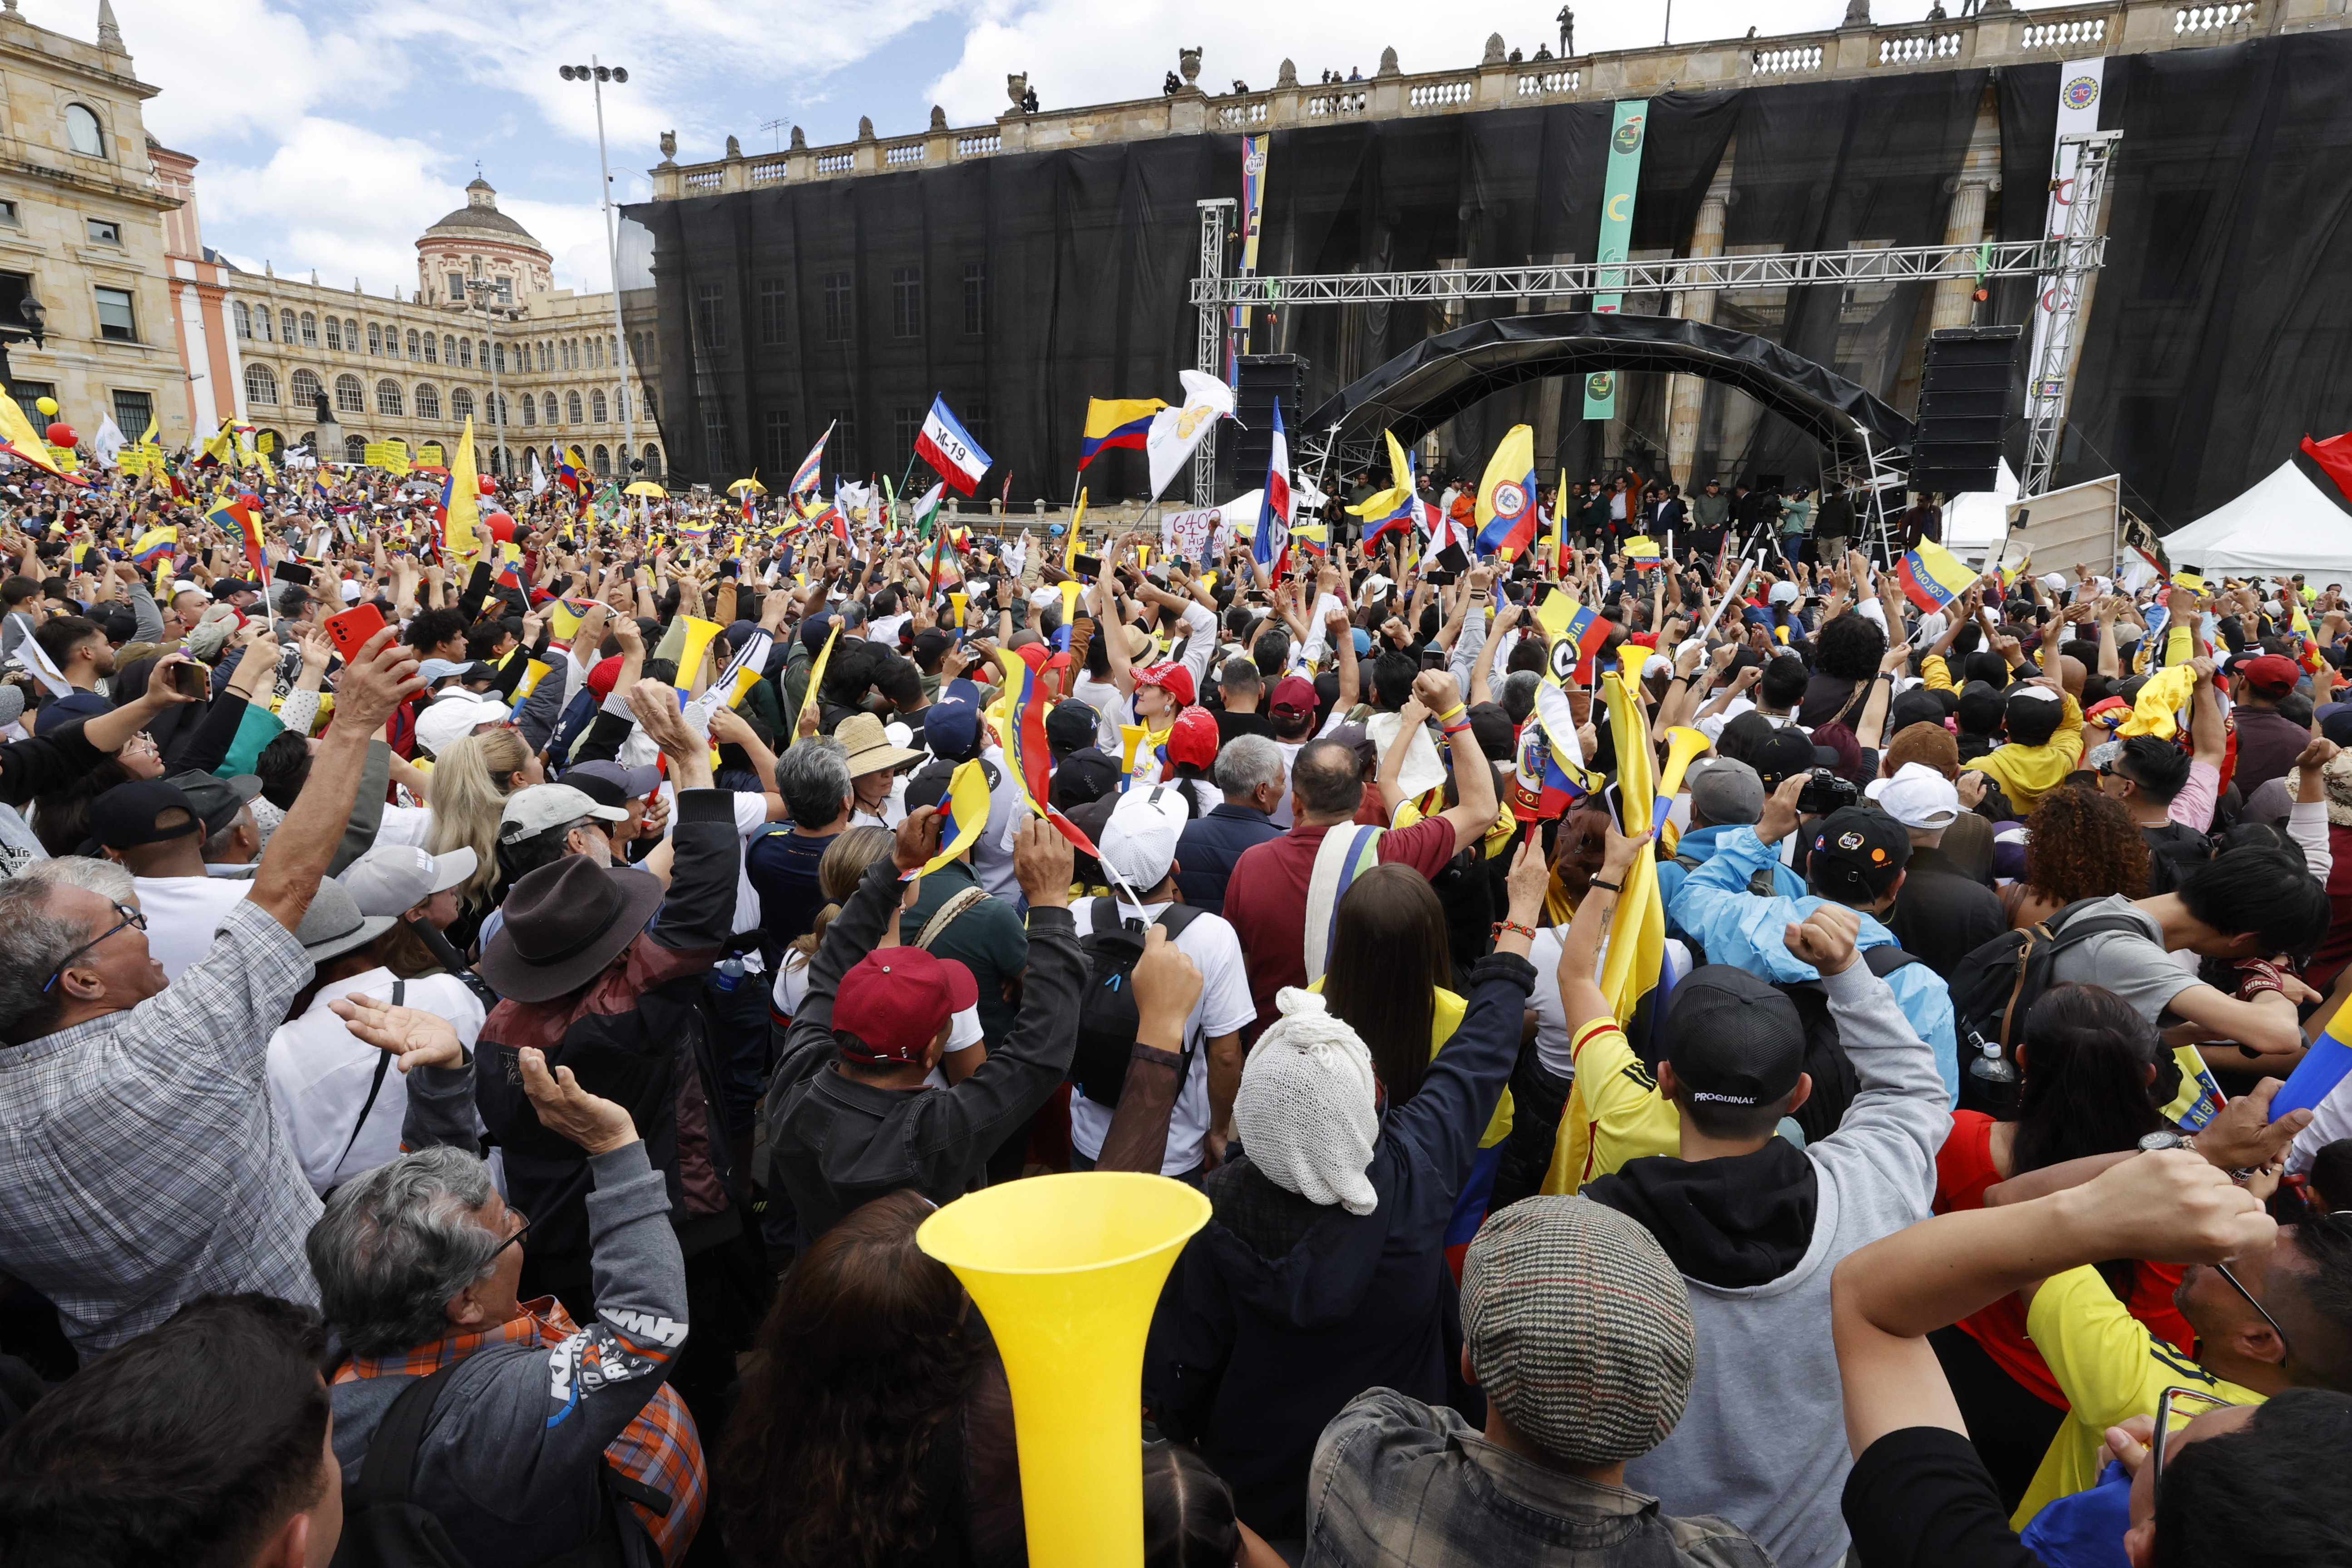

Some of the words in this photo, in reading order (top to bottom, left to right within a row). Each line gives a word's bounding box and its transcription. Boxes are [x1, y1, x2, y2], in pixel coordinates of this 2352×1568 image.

[2071, 88, 2090, 97] CTC
[1174, 509, 1224, 534] 6402
[1132, 766, 1144, 776] CTC
[2253, 963, 2280, 983] Nikon
[2244, 980, 2278, 993] Nikon
[1695, 1092, 1755, 1104] PROQUINAL
